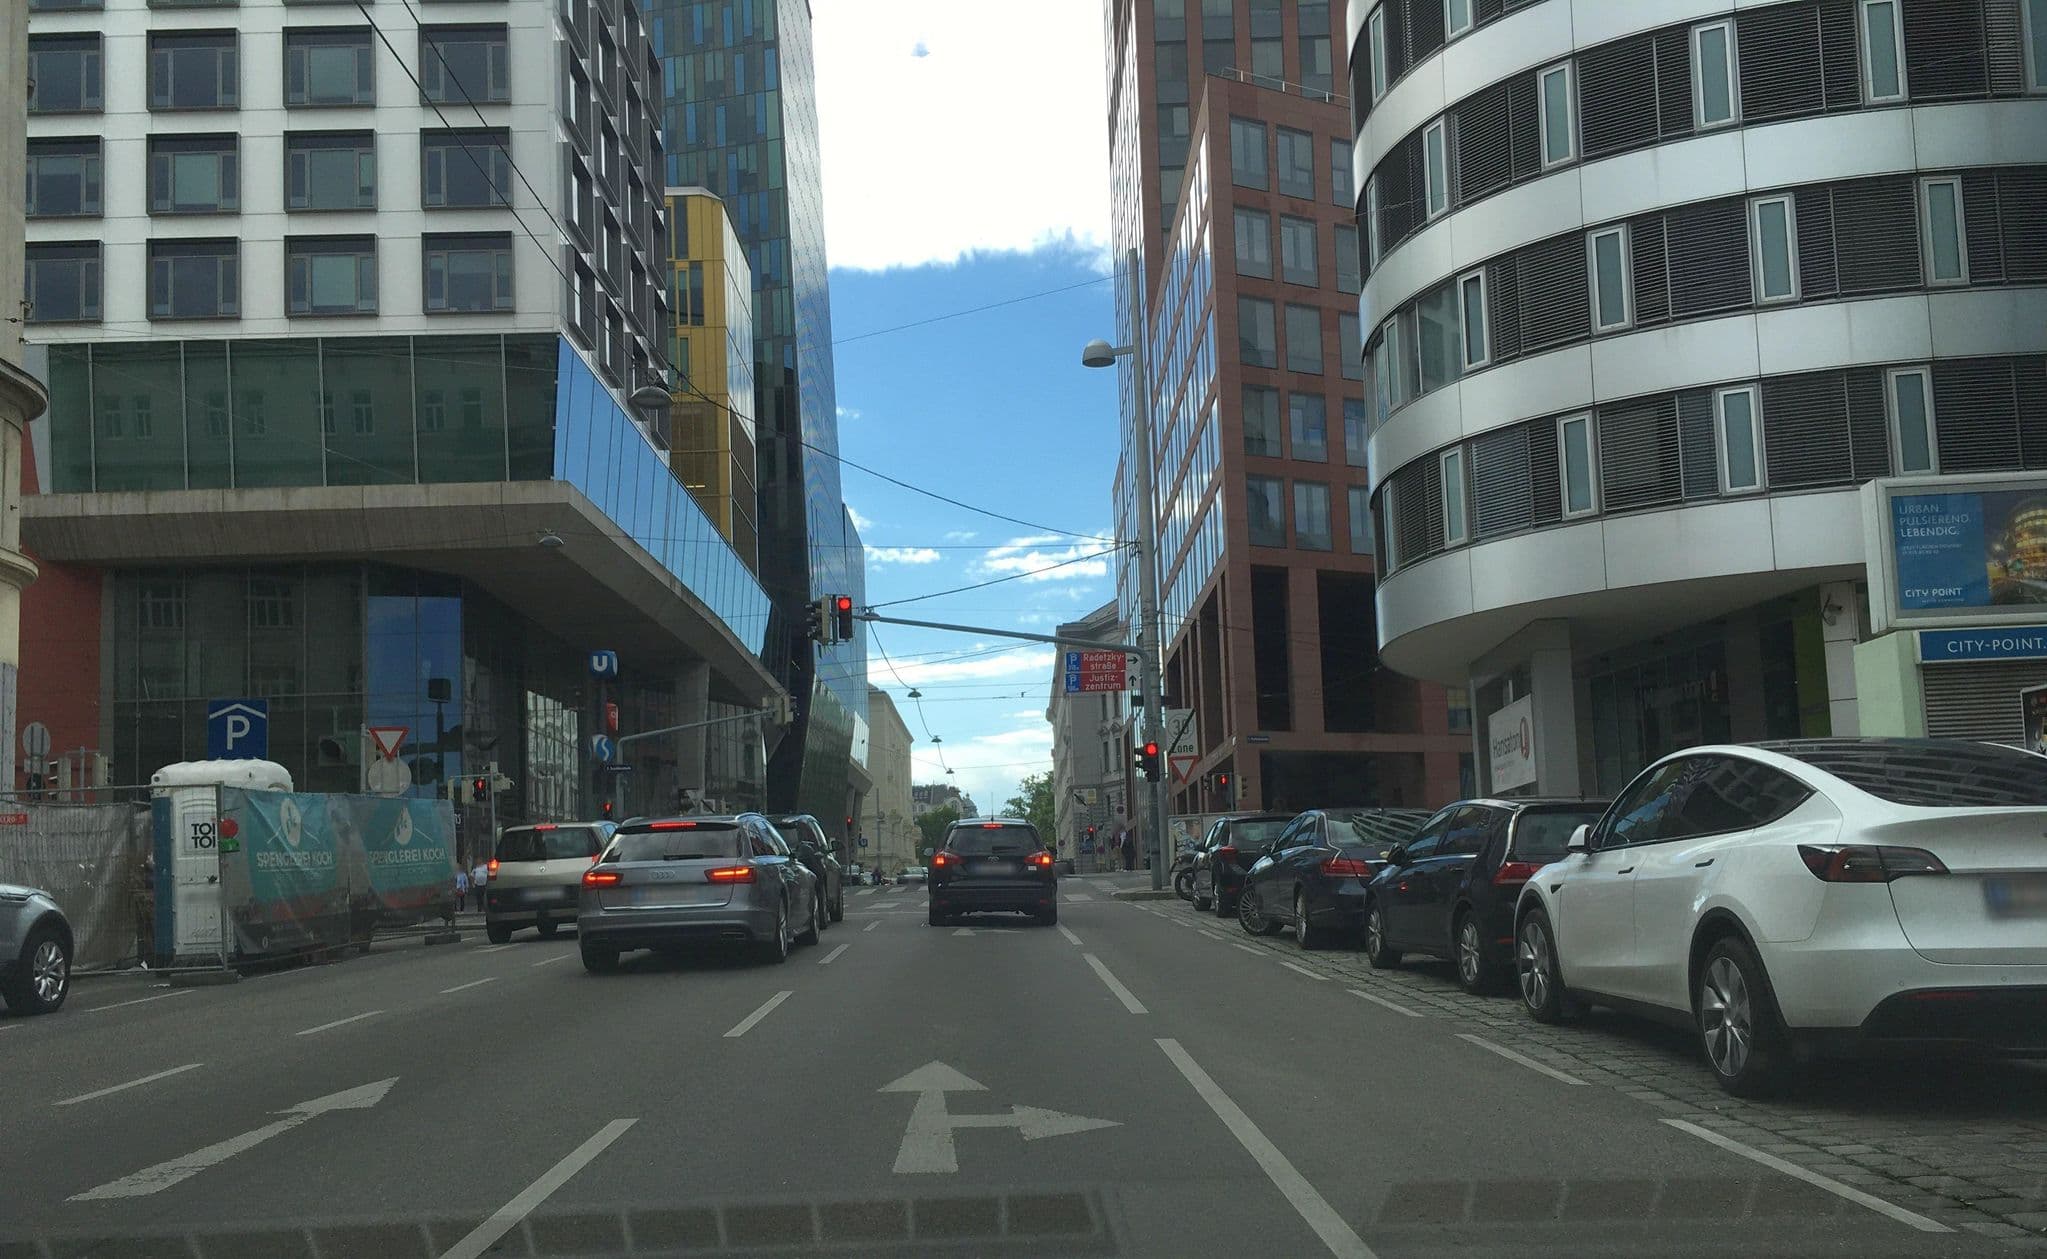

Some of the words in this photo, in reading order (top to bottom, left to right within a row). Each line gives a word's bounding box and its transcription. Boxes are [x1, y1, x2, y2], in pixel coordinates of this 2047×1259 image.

[1083, 653, 1124, 662] Radetzky-
[592, 655, 608, 672] U
[1090, 661, 1117, 670] straße
[1089, 674, 1118, 682] Justiz-
[1085, 682, 1121, 690] zentrum
[227, 715, 250, 750] P
[191, 823, 216, 835] TOI
[191, 836, 216, 849] TOI
